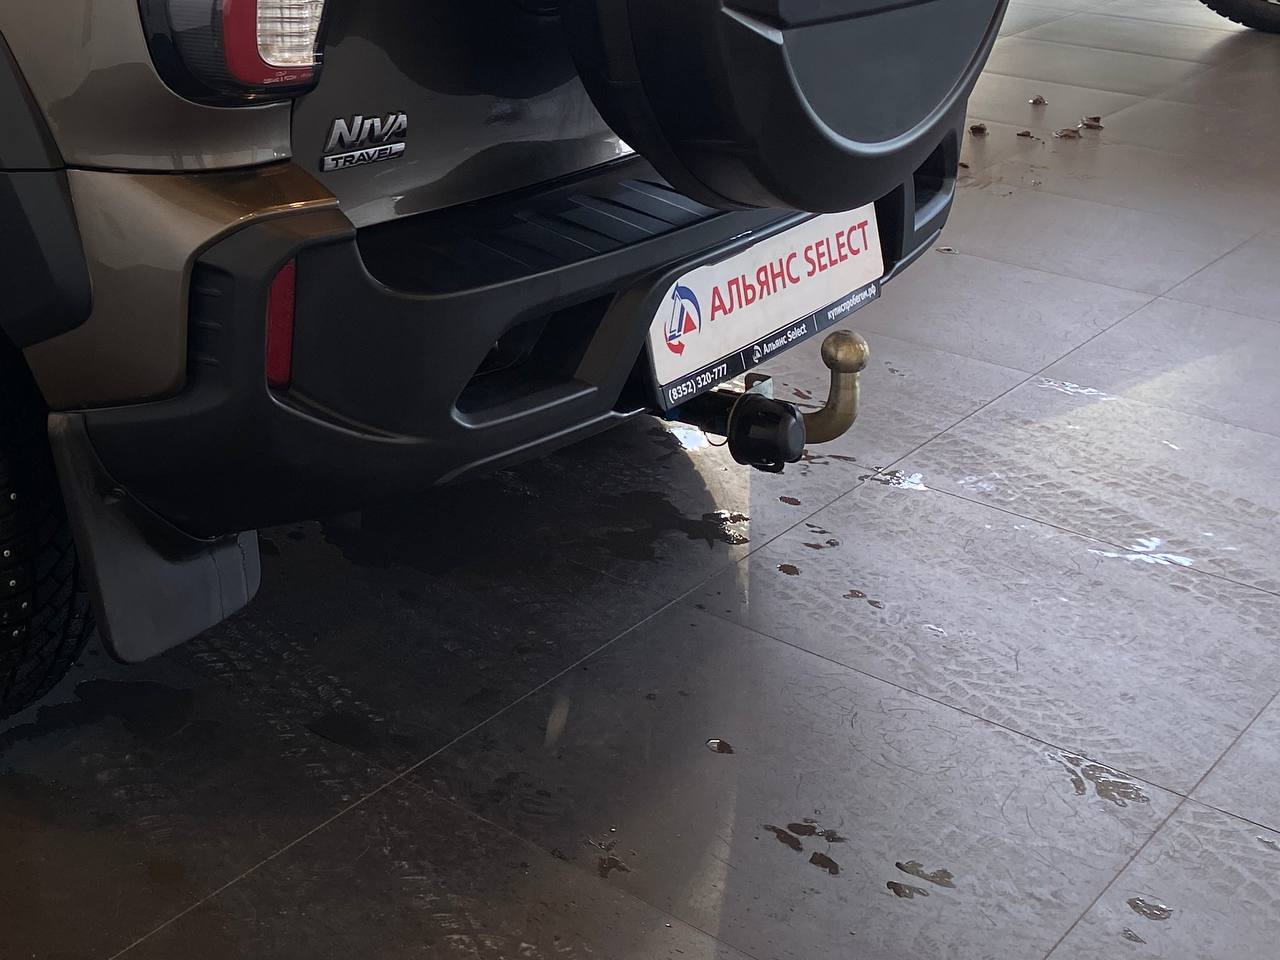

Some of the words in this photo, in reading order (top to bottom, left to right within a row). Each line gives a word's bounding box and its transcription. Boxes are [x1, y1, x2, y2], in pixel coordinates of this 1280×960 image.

[324, 112, 408, 153] NIVA
[331, 146, 395, 169] TRAVEL
[710, 253, 801, 321] АЛЬЯНС
[803, 220, 869, 277] SELECT
[827, 283, 877, 320] куписпробегом.рф
[763, 333, 787, 354] Альянс
[787, 323, 807, 342] Select
[668, 379, 696, 404] (8352)
[696, 364, 727, 387] 320-777
